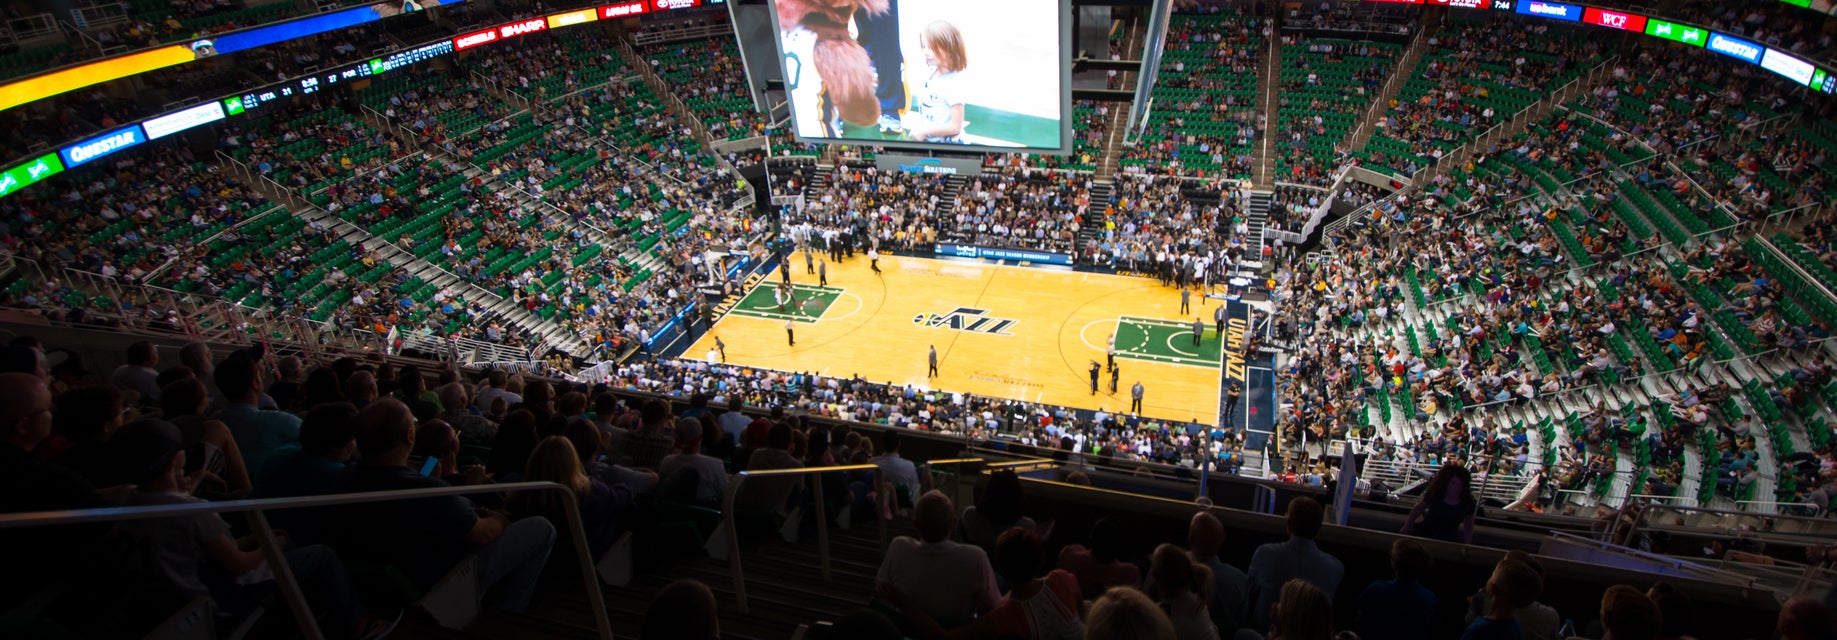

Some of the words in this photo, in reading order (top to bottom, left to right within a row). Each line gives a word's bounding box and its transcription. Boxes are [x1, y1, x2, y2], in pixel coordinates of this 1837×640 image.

[501, 20, 545, 37] SHARP
[1602, 12, 1627, 27] WCF
[1711, 35, 1759, 60] QUESTAR
[259, 92, 276, 102] UTA
[342, 69, 357, 79] POR
[71, 131, 136, 162] QUESTAR
[711, 295, 741, 321] UTAH
